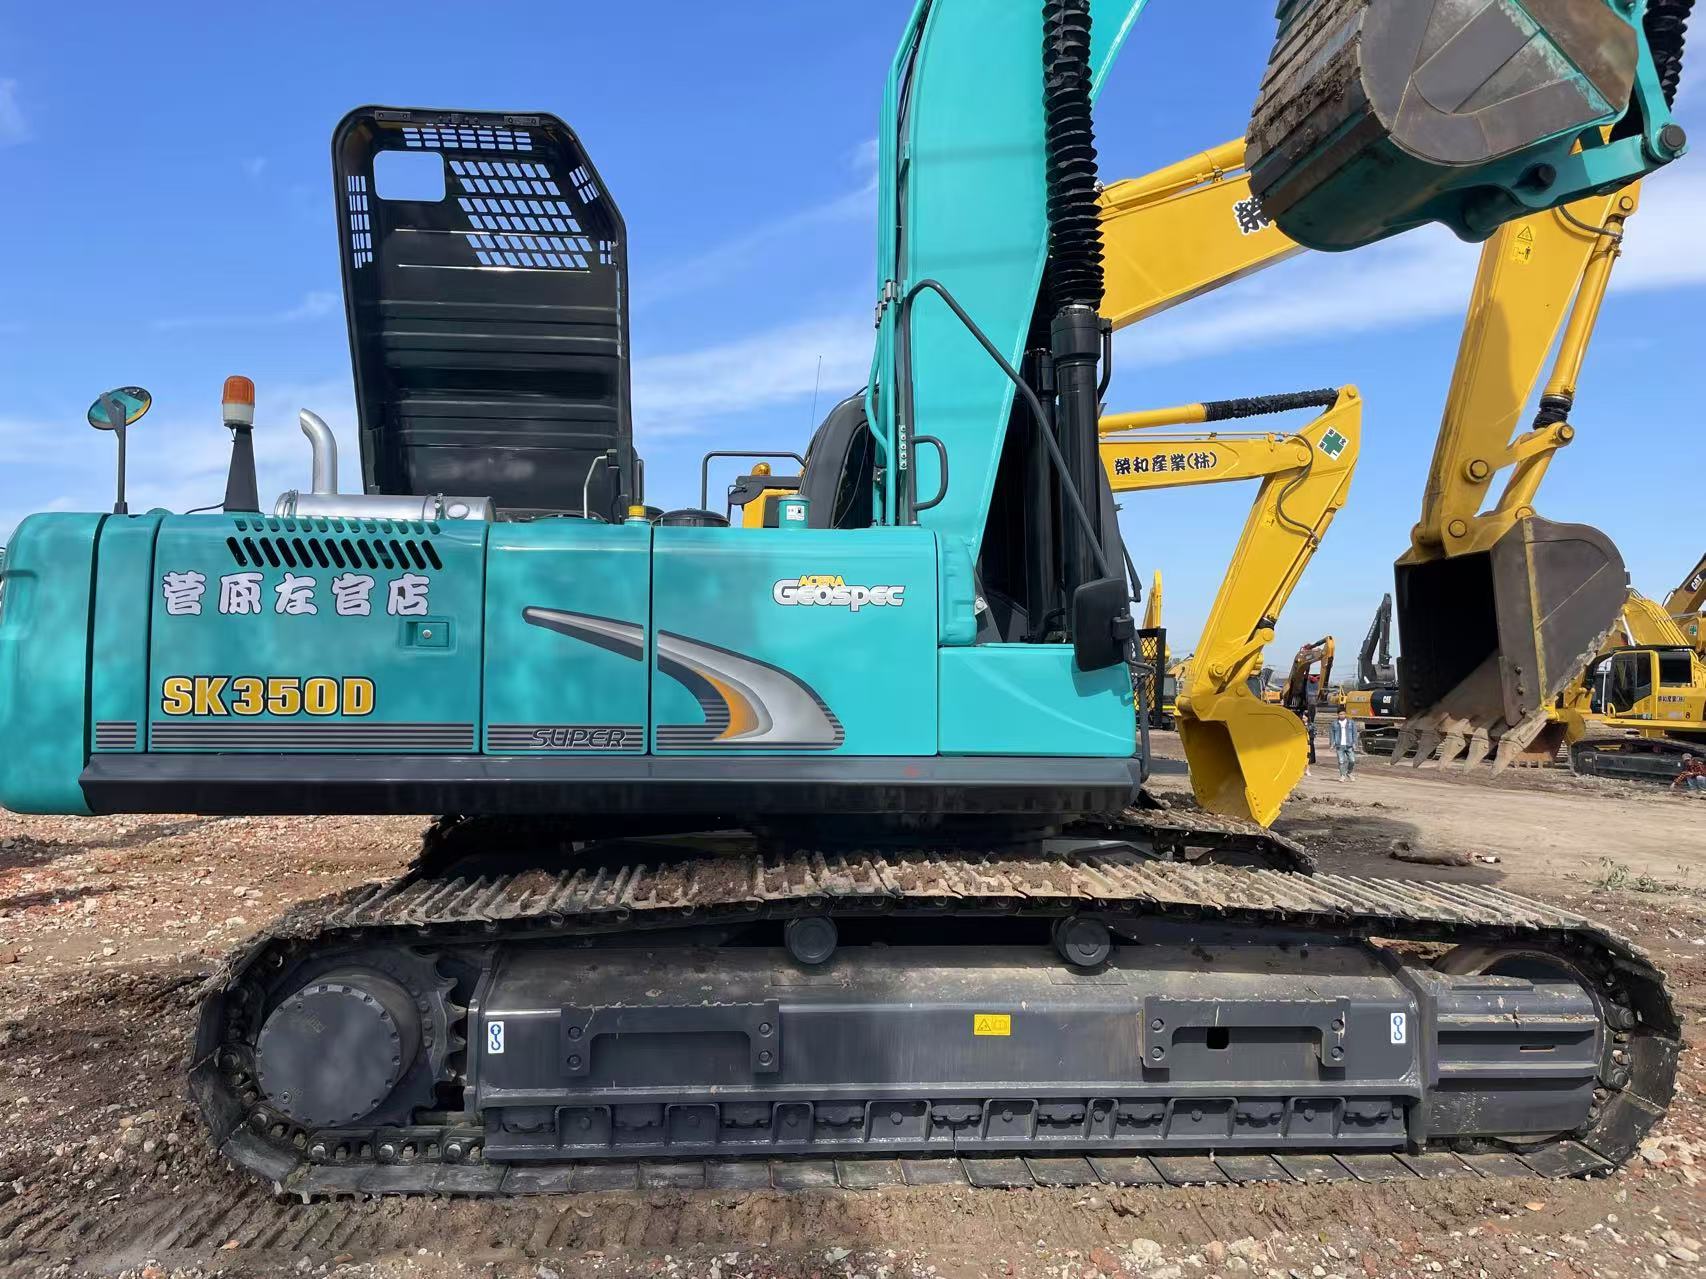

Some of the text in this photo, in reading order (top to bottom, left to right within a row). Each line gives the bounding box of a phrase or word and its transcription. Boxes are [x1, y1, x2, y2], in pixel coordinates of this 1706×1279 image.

[797, 575, 847, 588] ACERA
[1691, 574, 1703, 591] CAT
[162, 570, 431, 616] 菅原左官店
[161, 676, 376, 717] SK350D
[529, 728, 627, 749] SUPER
